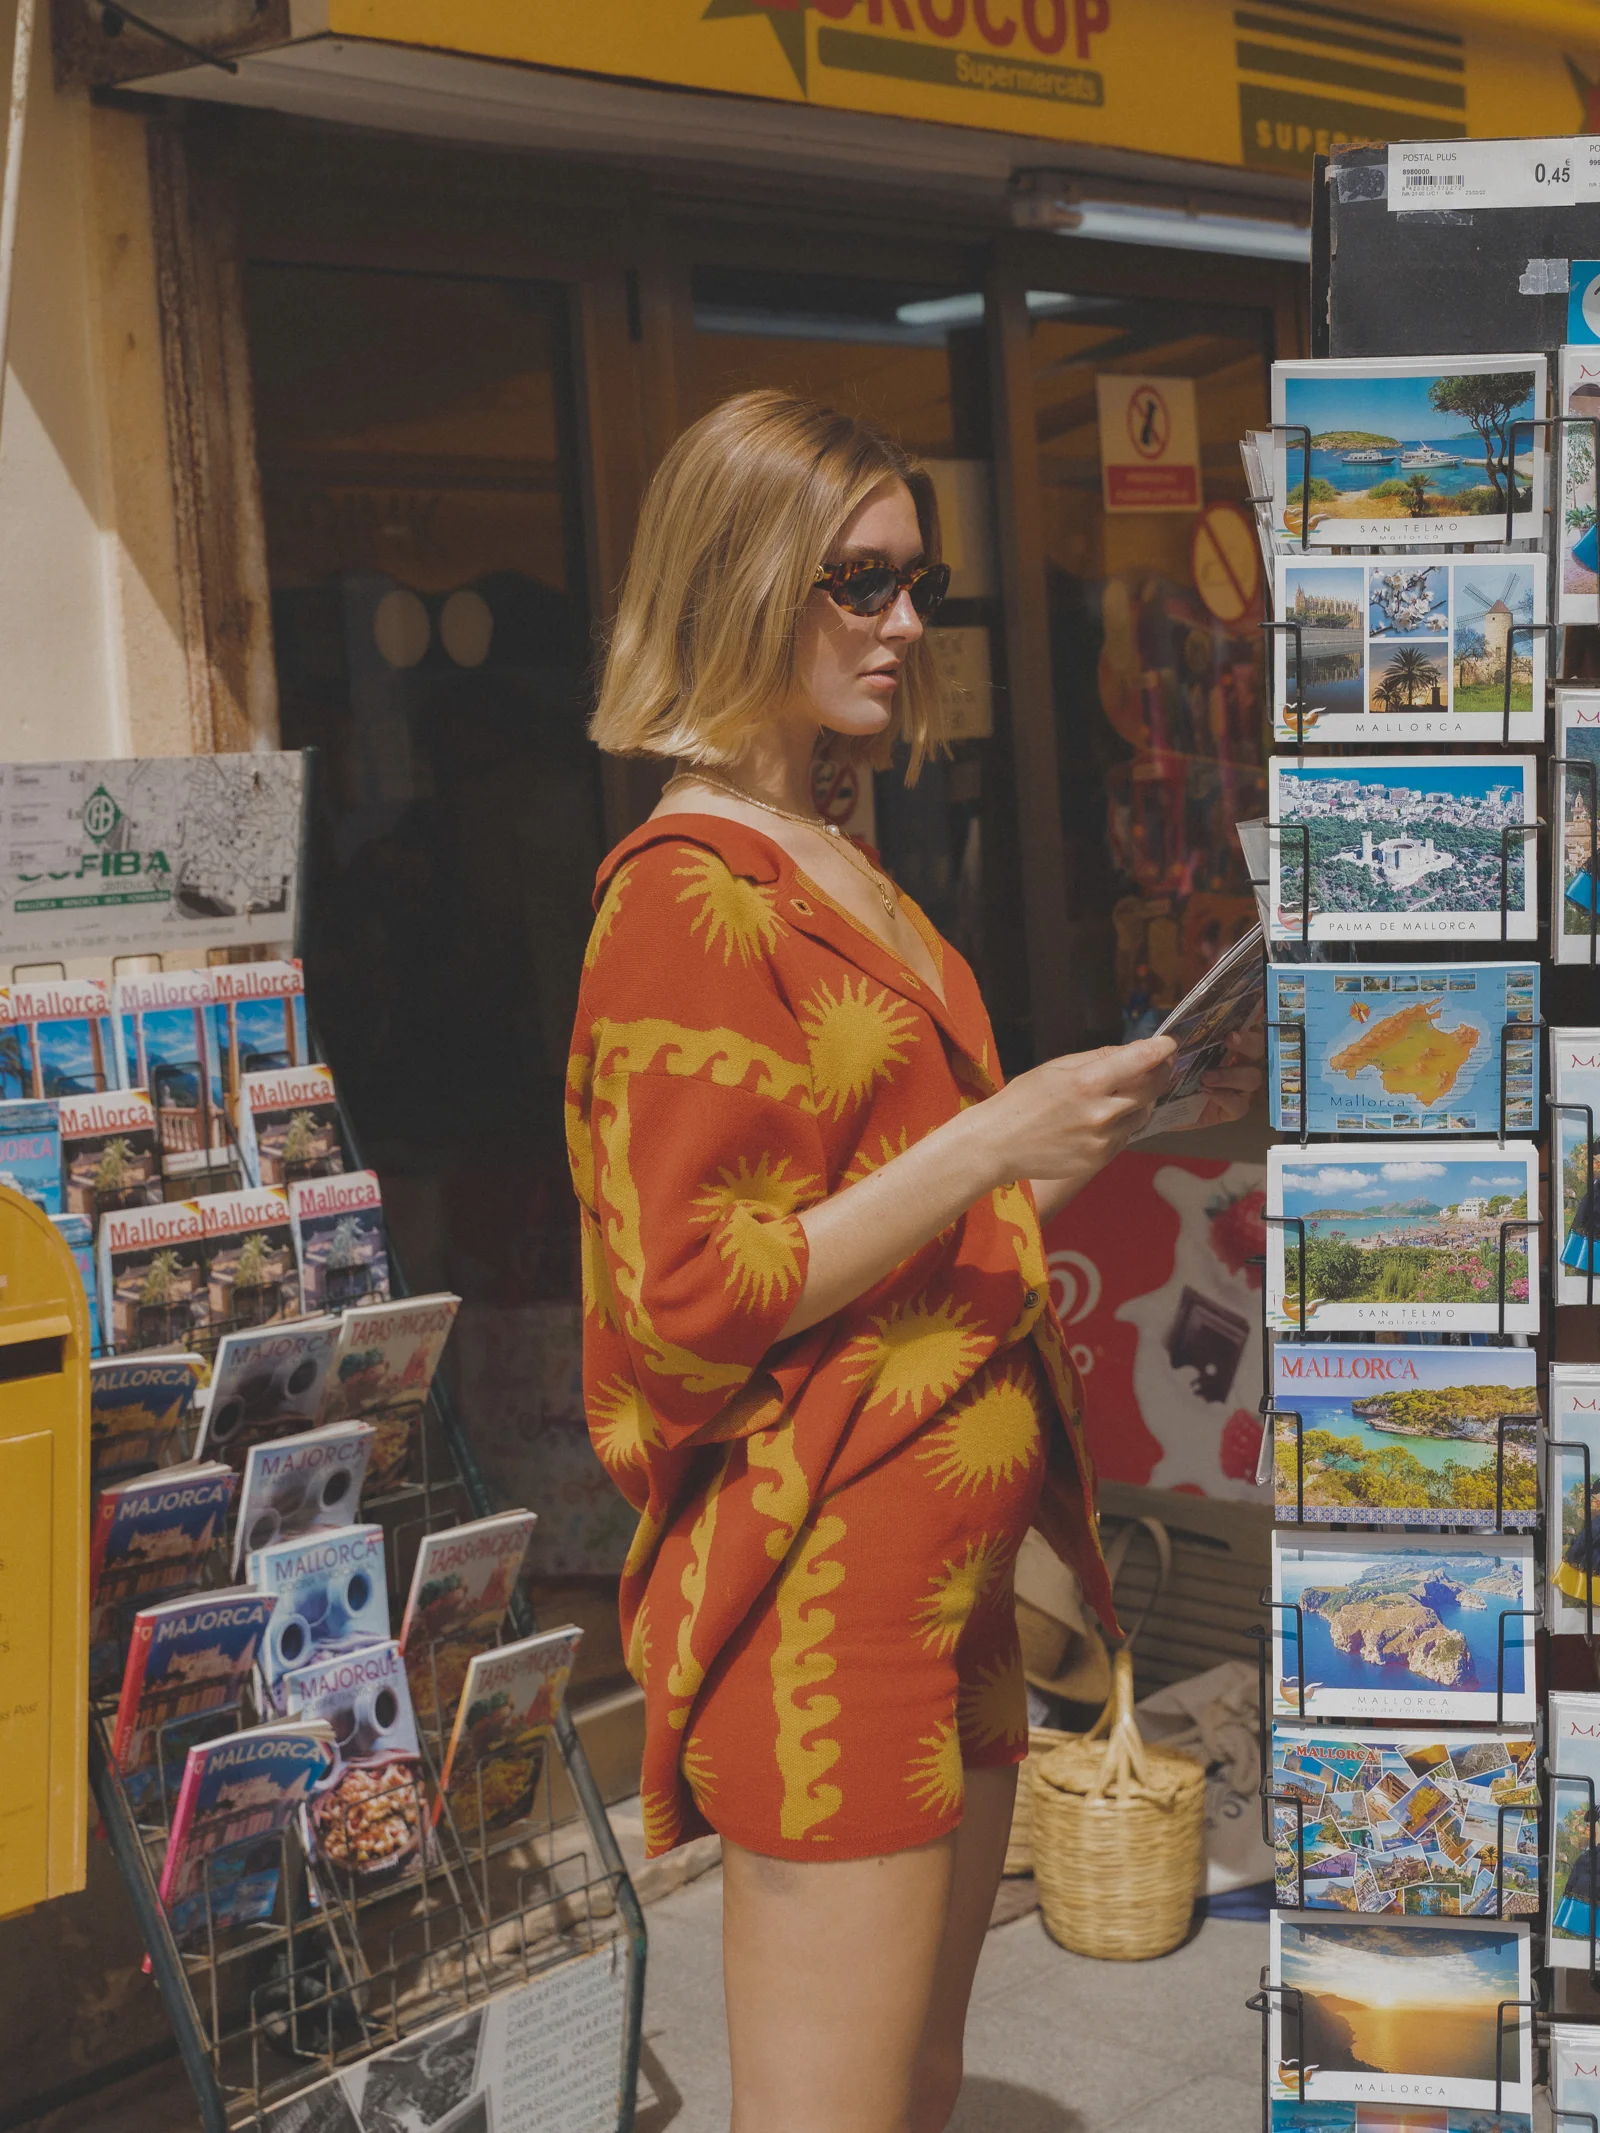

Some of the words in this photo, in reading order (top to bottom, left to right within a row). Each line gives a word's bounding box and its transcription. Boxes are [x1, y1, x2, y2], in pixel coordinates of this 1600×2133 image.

[742, 0, 1109, 60] OCOP
[1402, 154, 1434, 162] POSTAL
[1436, 153, 1457, 161] PLUS
[1534, 163, 1571, 186] 0,45
[1360, 525, 1391, 533] SAN
[1404, 523, 1458, 532] TELMO
[1355, 723, 1462, 732] MALLORCA
[16, 850, 172, 882] FIBA
[1329, 922, 1372, 931] PALMA
[1380, 922, 1395, 931] DE
[1402, 921, 1476, 930] MALLORCA
[120, 981, 213, 1010] Mallorca
[216, 971, 302, 998] Mallorca
[15, 991, 109, 1018] Mallorca
[250, 1079, 333, 1107] Mallorca
[1330, 1094, 1405, 1107] Mallorca
[60, 1104, 150, 1133] Mallorca
[299, 1182, 377, 1214] Mallorca
[110, 1213, 200, 1247] Mallorca
[201, 1200, 289, 1232] Mallorca
[1358, 1309, 1389, 1318] SAN
[1402, 1309, 1455, 1318] TELMO
[231, 1334, 332, 1366] MAJORCA
[1280, 1356, 1419, 1381] MALLORCA
[260, 1441, 368, 1476] MAJORCA
[119, 1483, 224, 1521] MAJORCA
[275, 1538, 378, 1582] MALLORCA
[158, 1606, 265, 1643] MAJORCA
[299, 1654, 398, 1700] MAJORQUE
[1357, 1696, 1449, 1706] MALLORCA
[208, 1741, 322, 1774] MALLORCA
[1295, 1745, 1377, 1761] MALLORCA
[1354, 2083, 1445, 2096] MALLORCA
